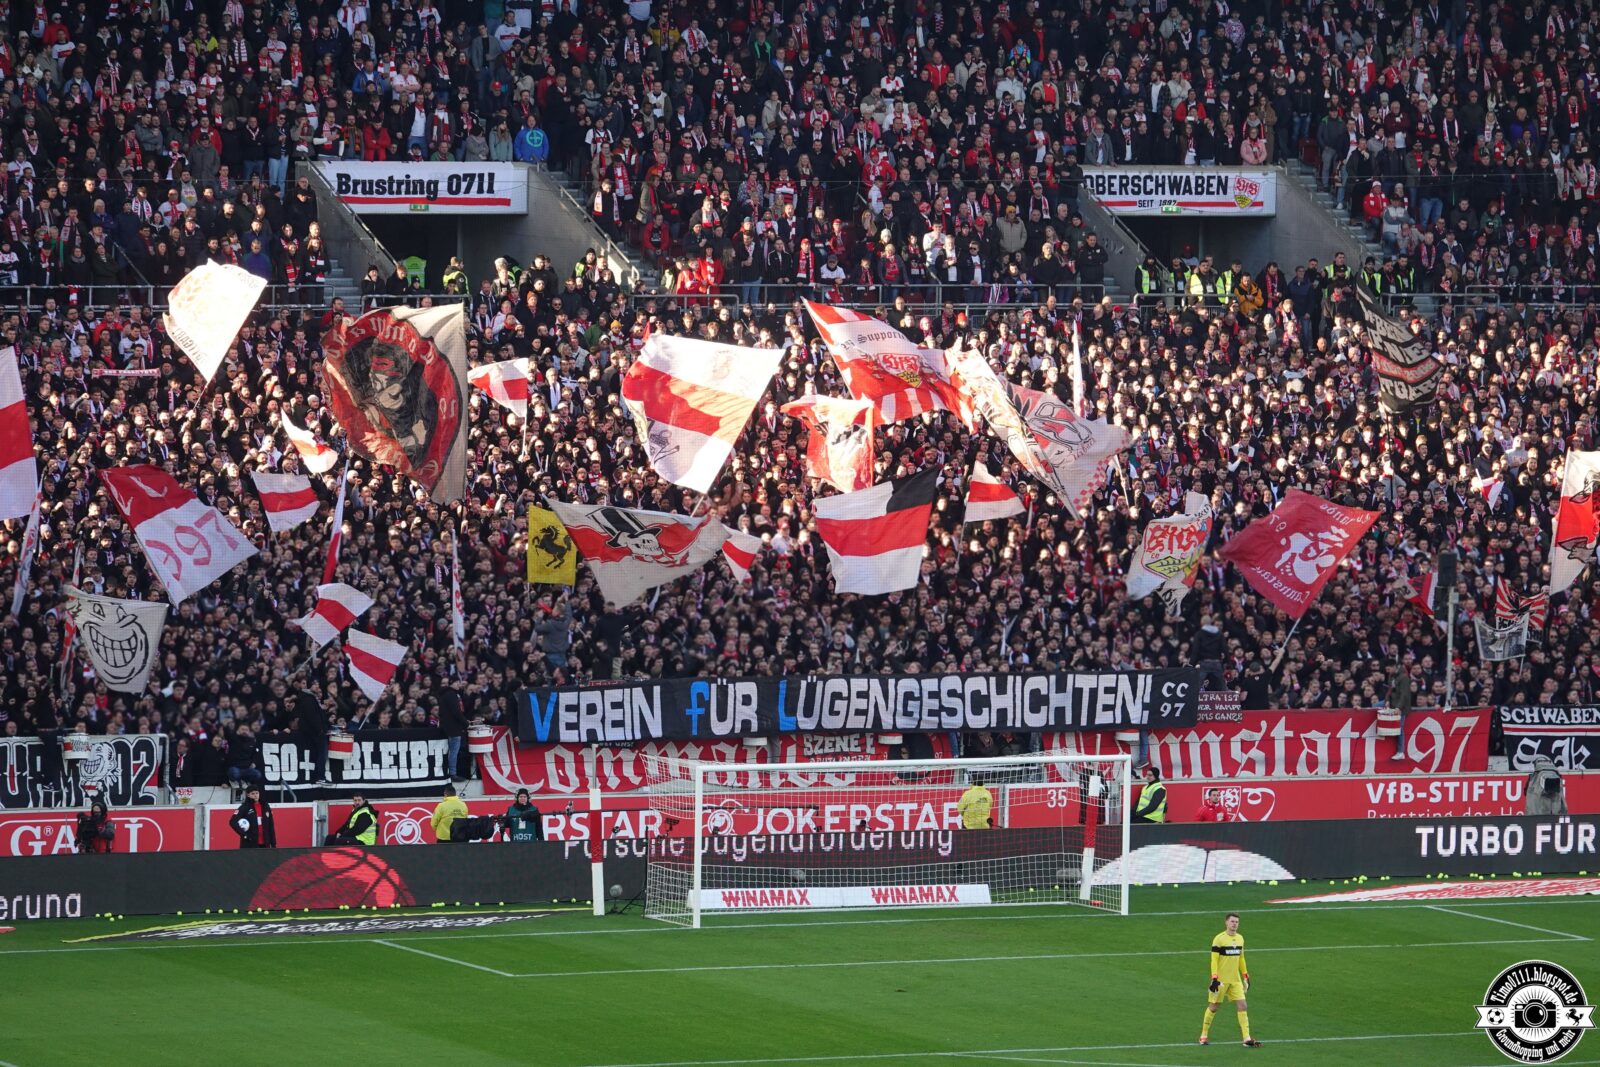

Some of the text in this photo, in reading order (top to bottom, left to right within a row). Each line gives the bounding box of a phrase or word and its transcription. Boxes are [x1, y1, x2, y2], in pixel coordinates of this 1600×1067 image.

[336, 172, 496, 201] Brustring 0711
[1085, 174, 1229, 196] OBERSCHWABEN
[1138, 199, 1154, 208] SEIT
[1161, 681, 1190, 699] CC
[528, 675, 1153, 743] VEREIN fÜR LÜGENGESCHICHTEN!
[1159, 702, 1187, 718] 97
[1501, 706, 1600, 724] SCHWABEN
[803, 733, 862, 756] SZENE
[1407, 716, 1480, 774] 97
[342, 738, 449, 781] BLEIBT
[1047, 789, 1067, 808] 35
[1415, 816, 1596, 858] TURBO FÜR
[721, 885, 960, 908] WINAMAX WINAMAX
